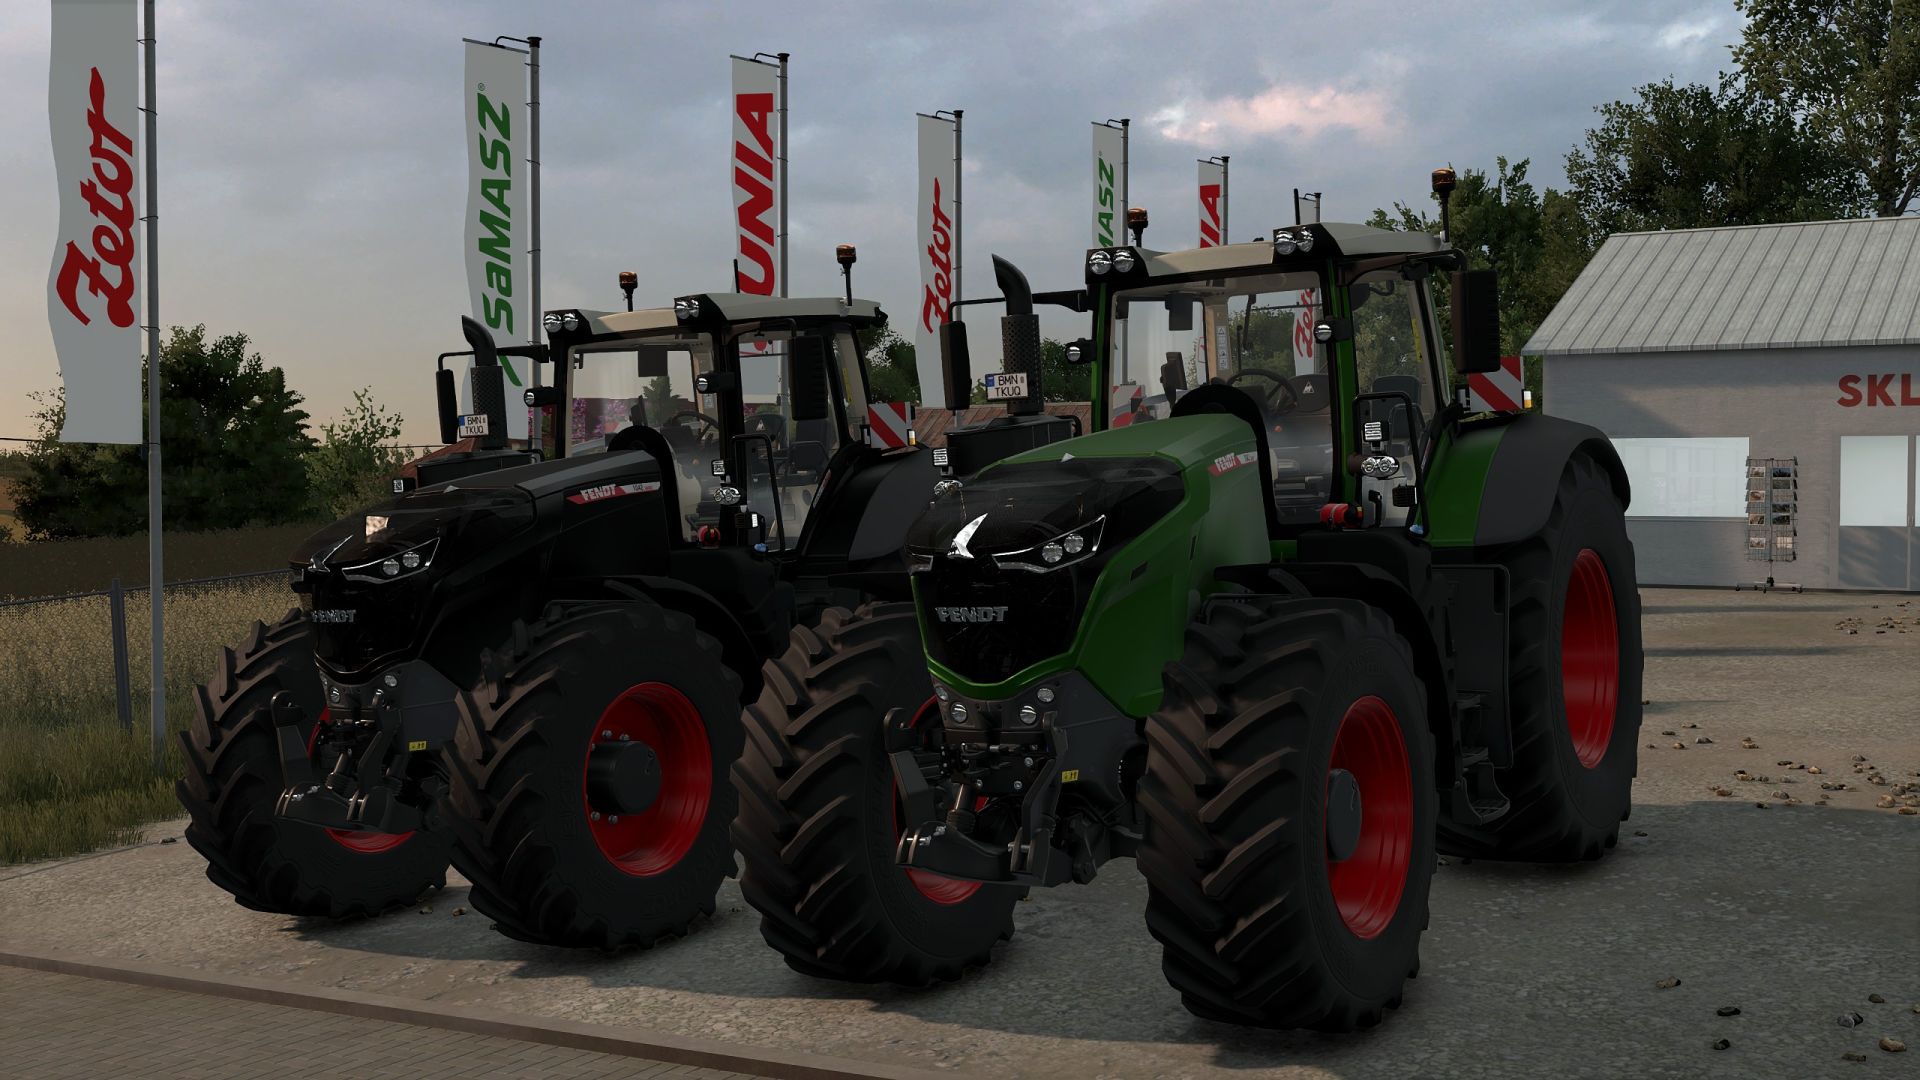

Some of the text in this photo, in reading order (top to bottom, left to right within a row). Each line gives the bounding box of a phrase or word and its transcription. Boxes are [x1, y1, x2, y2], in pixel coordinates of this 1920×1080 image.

[56, 66, 135, 328] Zetor
[735, 93, 775, 297] UNIA
[923, 177, 951, 334] Zetor
[997, 375, 1018, 386] BMN
[1837, 373, 1920, 407] SKL
[580, 484, 616, 501] FENDT
[311, 609, 357, 623] FENDT
[935, 606, 1008, 622] FENDT
